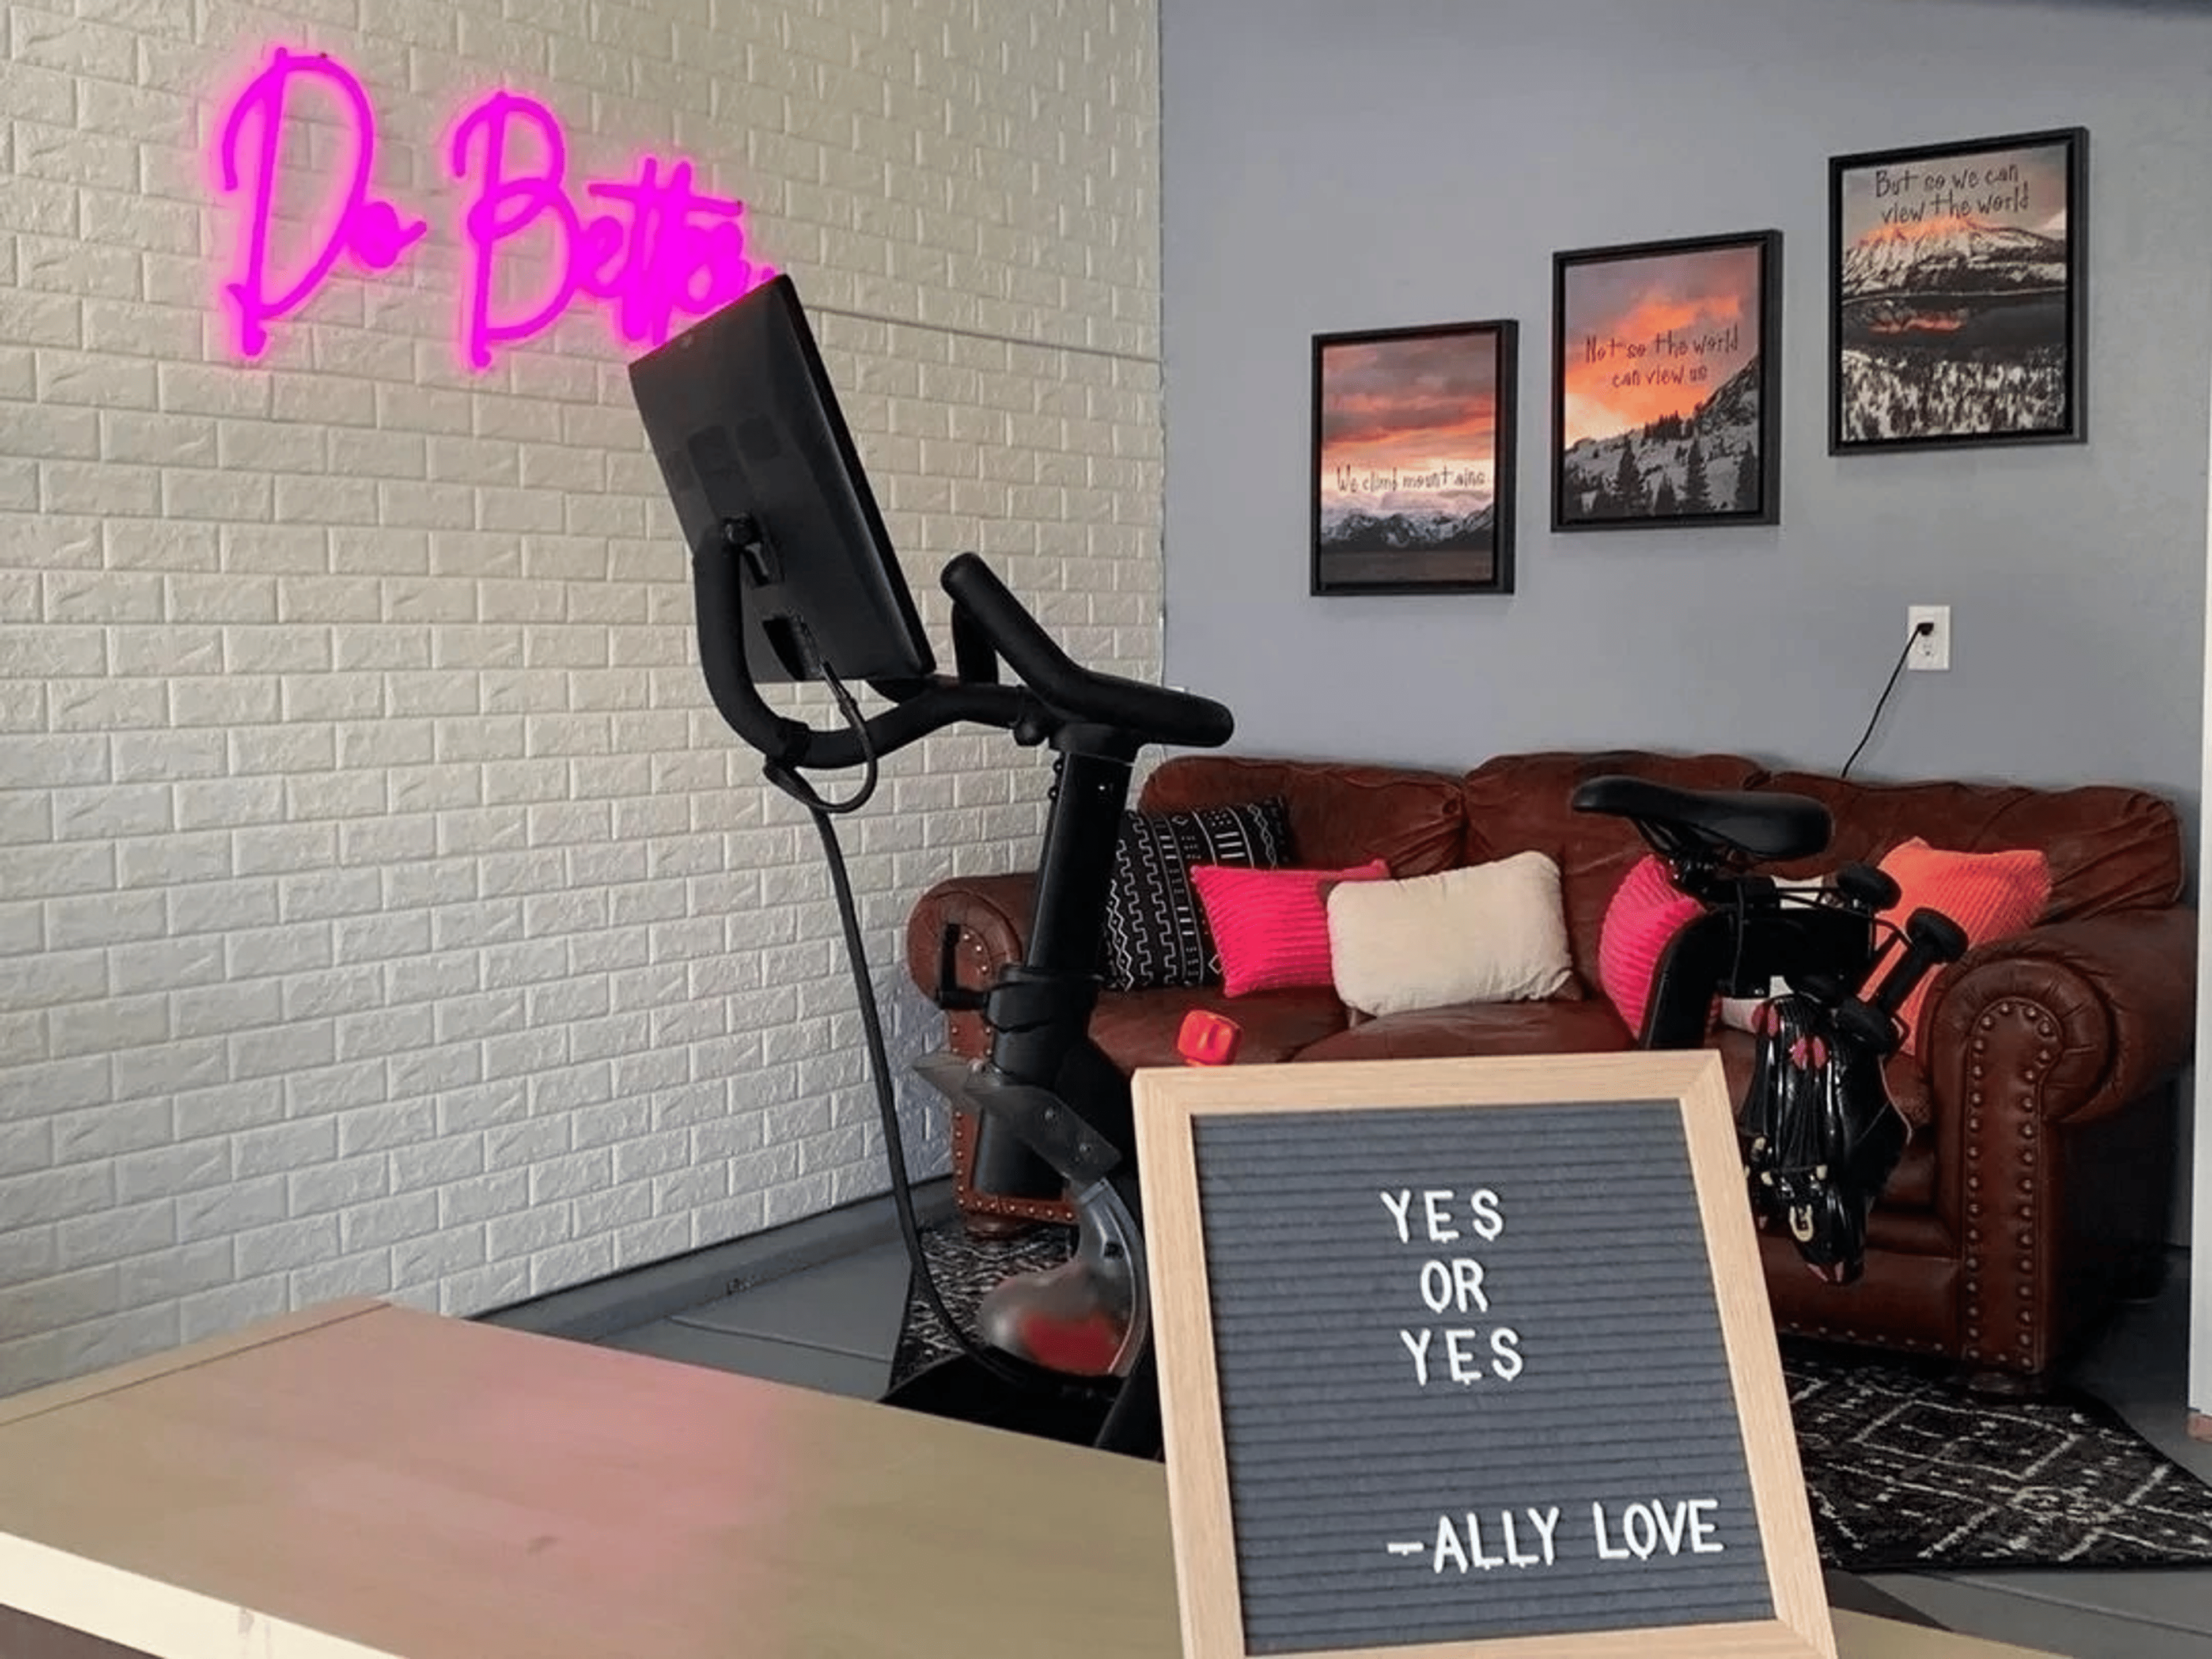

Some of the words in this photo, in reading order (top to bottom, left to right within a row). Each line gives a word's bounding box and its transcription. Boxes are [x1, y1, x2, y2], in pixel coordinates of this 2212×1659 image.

[222, 47, 427, 357] Do
[1876, 170, 1918, 197] But
[1924, 176, 1946, 191] so
[1952, 169, 1978, 190] we
[1985, 164, 2020, 184] can
[1882, 200, 1926, 224] view
[1930, 190, 1970, 218] the
[1978, 181, 2030, 215] world
[1585, 334, 1625, 364] Not
[1626, 344, 1646, 359] so
[1652, 329, 1689, 358] the
[1692, 323, 1738, 355] world
[1612, 370, 1641, 388] can
[1645, 364, 1685, 386] view
[1689, 364, 1709, 381] us
[1336, 463, 1358, 493] We
[1362, 466, 1398, 494] climb
[1402, 464, 1486, 490] mountains
[1381, 1190, 1502, 1243] YES
[1421, 1259, 1487, 1313] OR
[1401, 1328, 1522, 1385] YES
[1593, 1499, 1723, 1560] LOVE
